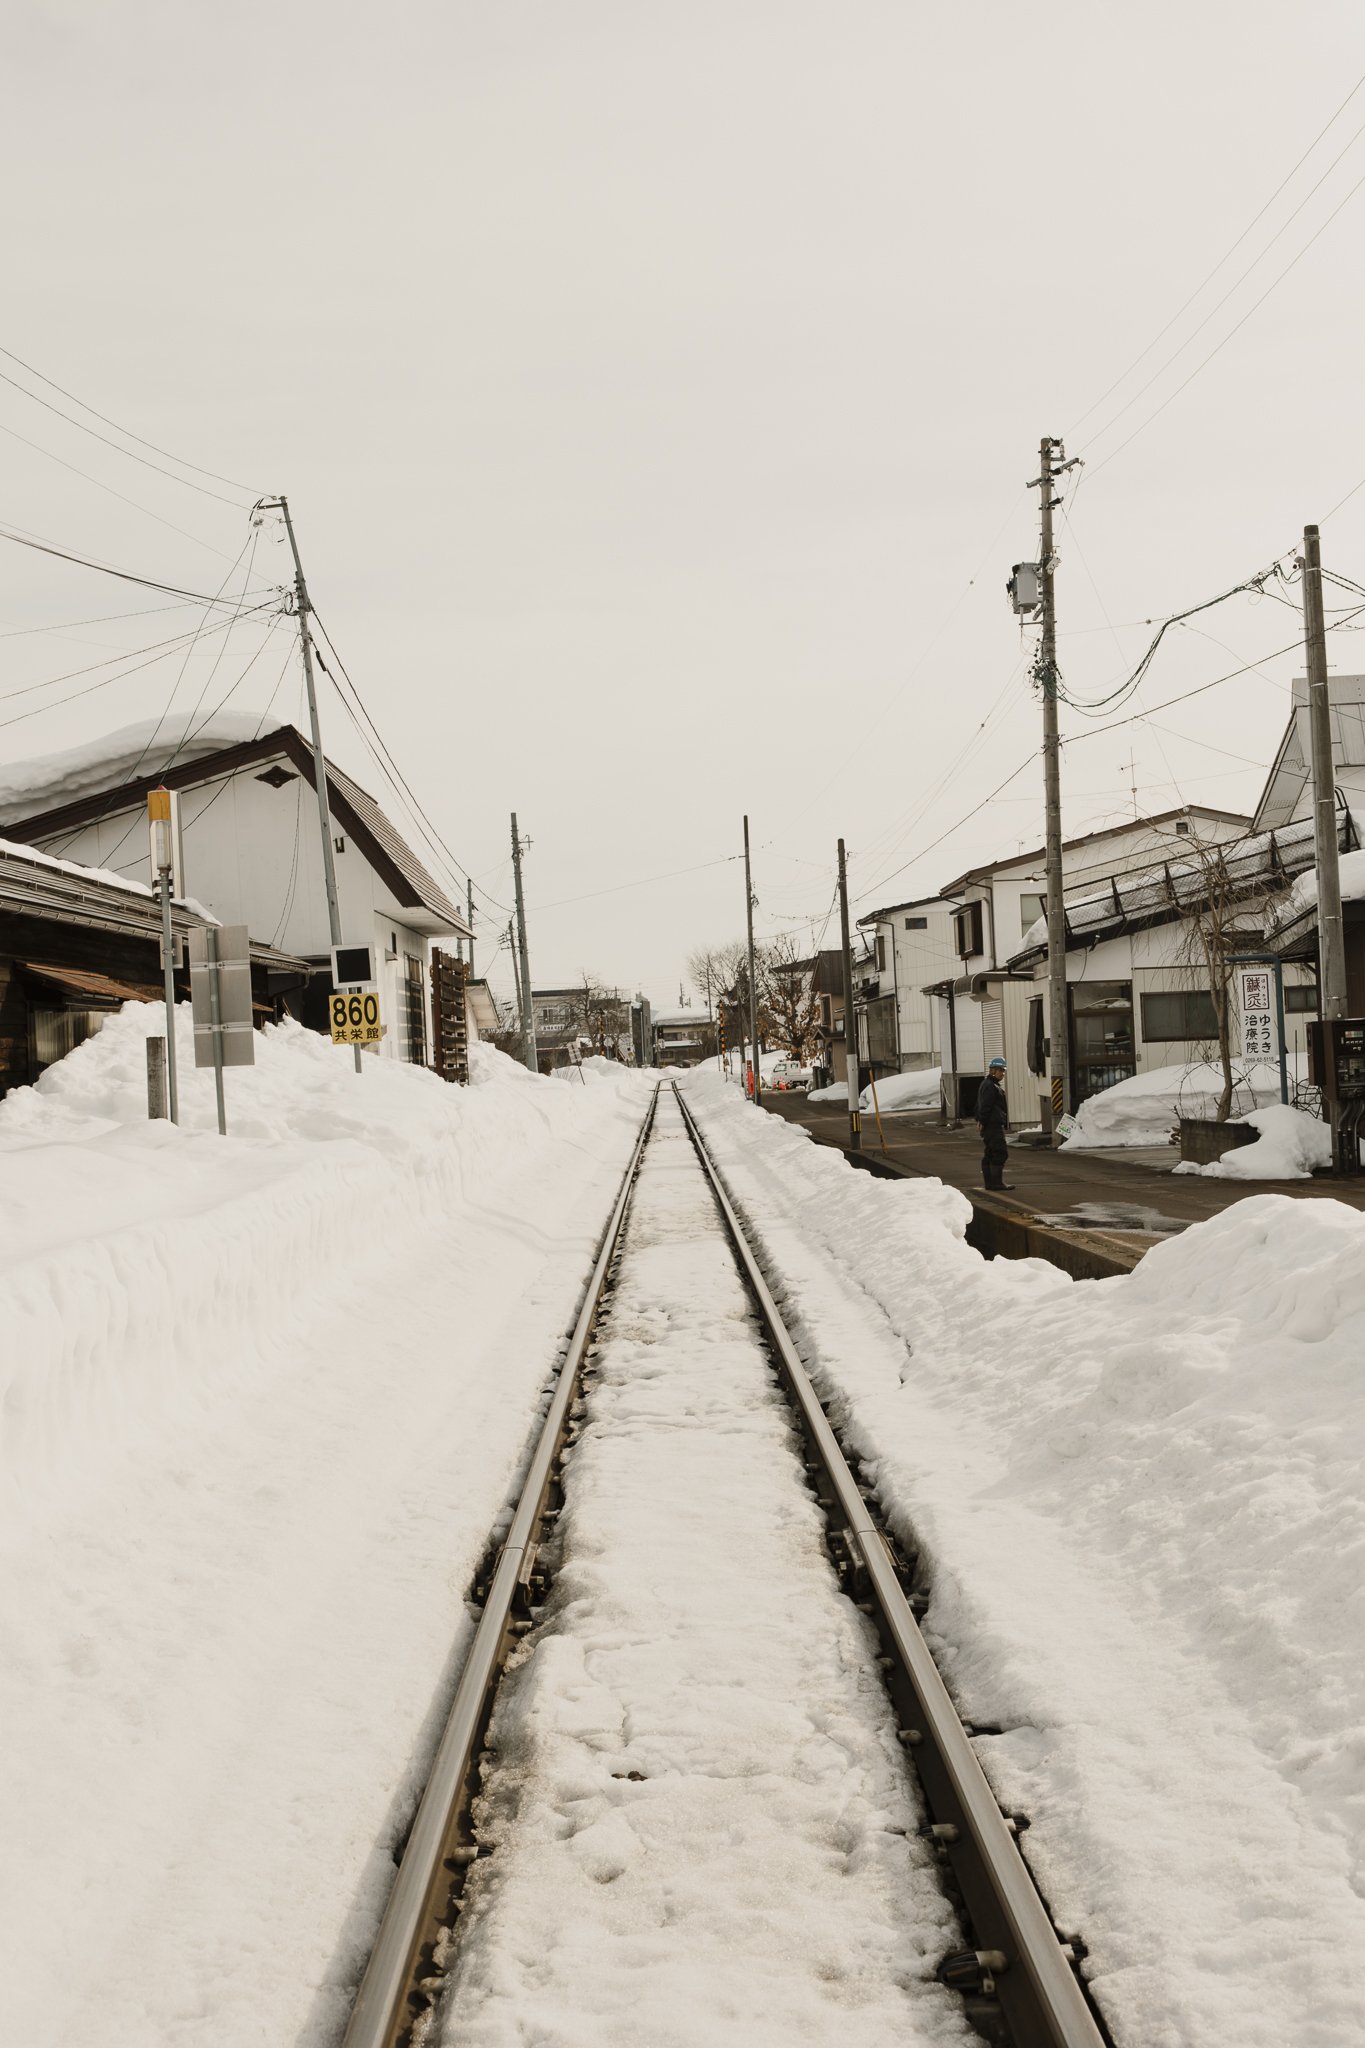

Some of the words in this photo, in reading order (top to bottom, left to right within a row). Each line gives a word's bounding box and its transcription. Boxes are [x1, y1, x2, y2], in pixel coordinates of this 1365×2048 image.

[1246, 977, 1261, 1008] 鍼灸
[333, 995, 377, 1027] 860
[335, 1027, 378, 1041] 共栄館
[1245, 1014, 1258, 1053] 治療院
[1259, 1014, 1271, 1053] ゆうき
